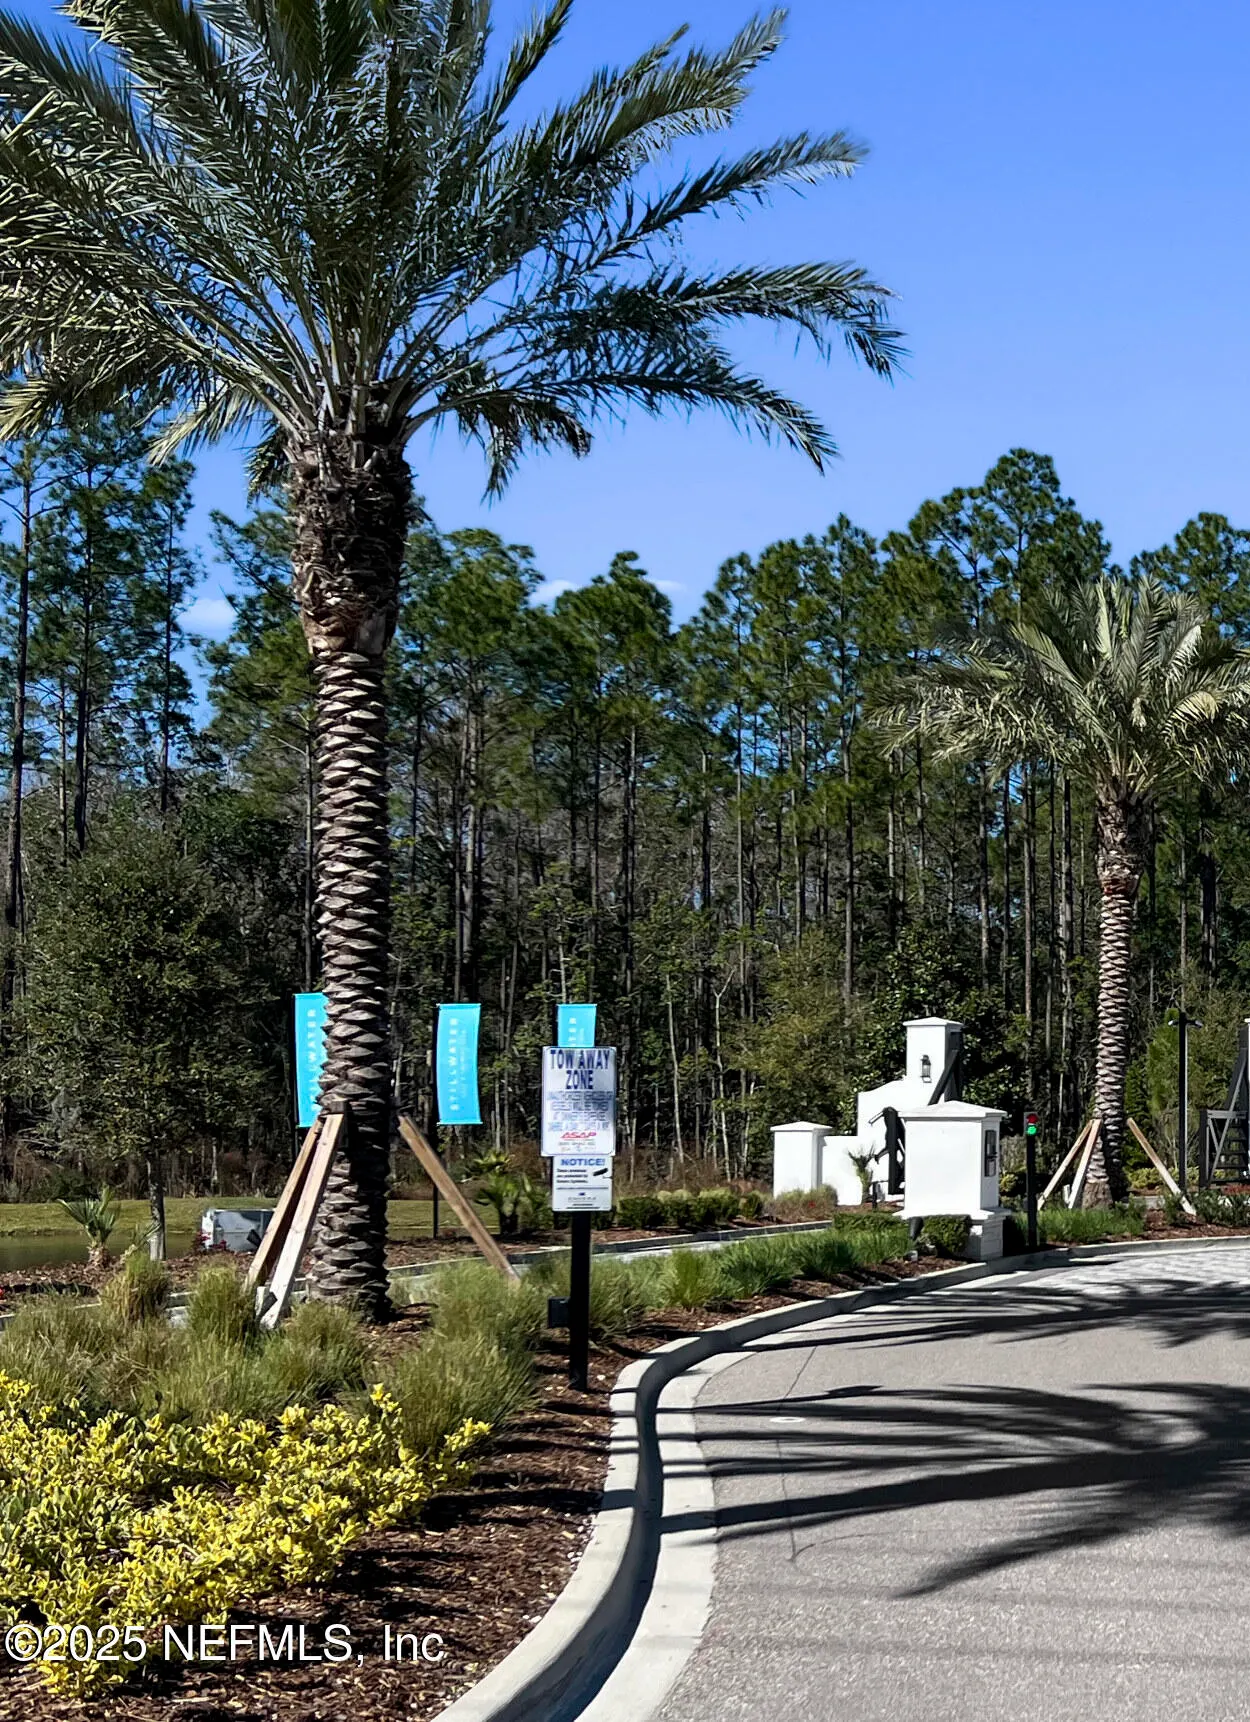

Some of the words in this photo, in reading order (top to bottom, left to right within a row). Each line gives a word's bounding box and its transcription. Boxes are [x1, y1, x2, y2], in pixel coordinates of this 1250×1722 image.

[448, 1018, 459, 1112] STILLWATER
[550, 1049, 573, 1069] TOW
[578, 1050, 610, 1069] AWAY
[565, 1070, 594, 1090] ZONE
[560, 1131, 598, 1139] ASAP
[560, 1158, 606, 1166] NOTICE!
